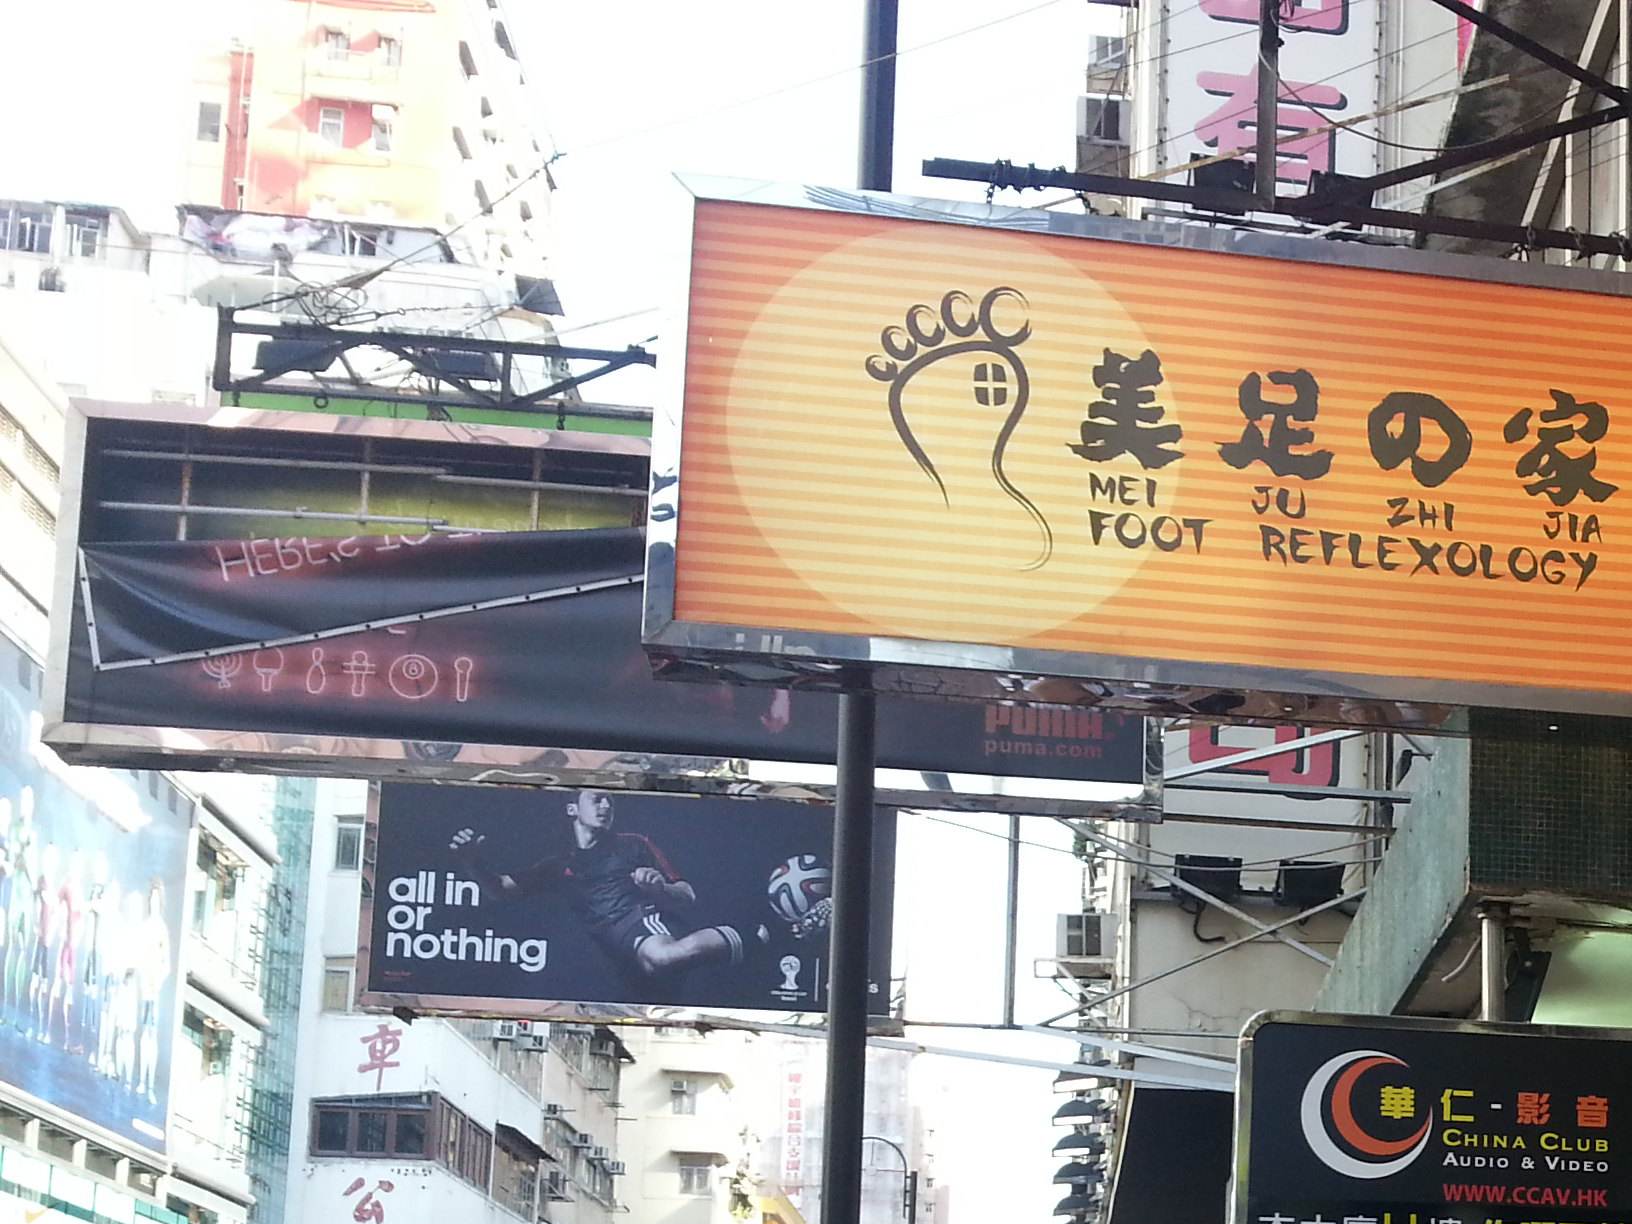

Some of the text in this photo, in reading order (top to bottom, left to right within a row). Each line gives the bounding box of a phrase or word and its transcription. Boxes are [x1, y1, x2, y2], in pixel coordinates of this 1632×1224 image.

[1066, 347, 1619, 507] 美足の家
[1089, 472, 1603, 543] MEI JU ZHI JIA
[1087, 509, 1599, 591] FOOT REFLEXOLOGY
[984, 739, 1103, 759] puma.com
[387, 871, 480, 907] all in
[386, 901, 432, 932] or
[385, 927, 548, 973] nothing
[1442, 1128, 1610, 1153] CHINA CLUB
[1442, 1151, 1610, 1173] AUDIO & VIDEO
[1442, 1183, 1608, 1208] WWW.CCAV.HK
